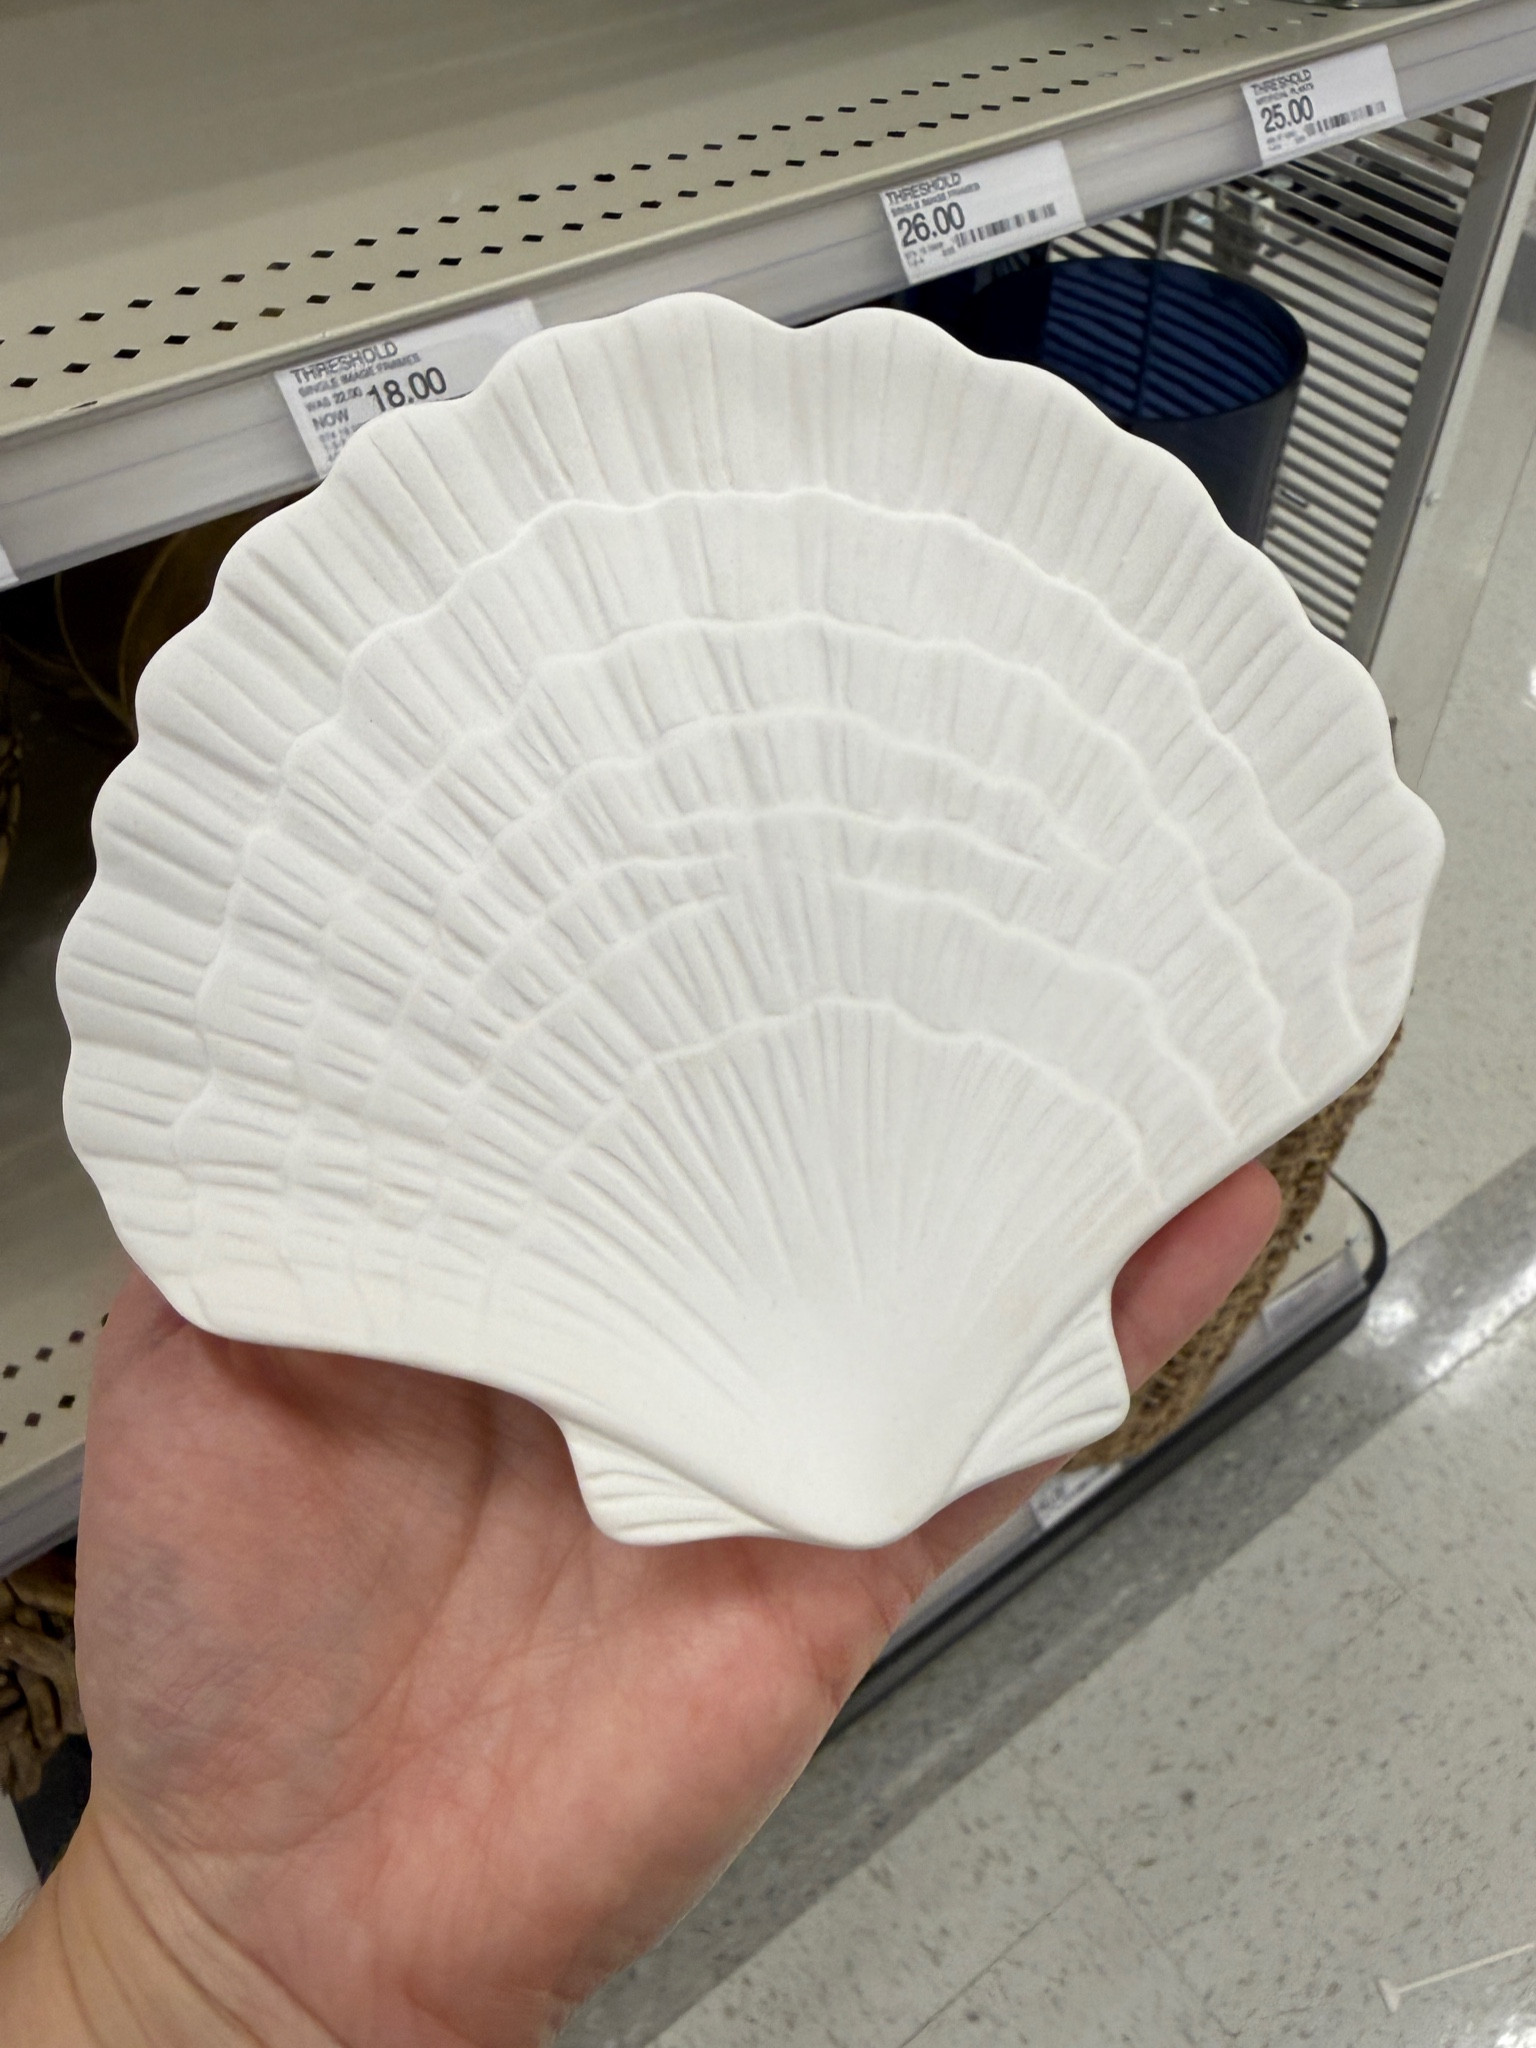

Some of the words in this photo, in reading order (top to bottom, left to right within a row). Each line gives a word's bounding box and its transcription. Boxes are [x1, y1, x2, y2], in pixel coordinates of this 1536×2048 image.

[1250, 69, 1312, 95] THRESHOLD
[1261, 95, 1314, 133] 25.00
[885, 172, 961, 205] THRESHOLD
[897, 202, 965, 247] 26.00
[290, 341, 398, 384] THRESHOLD
[312, 408, 350, 431] NOW
[365, 366, 447, 413] 18.00
